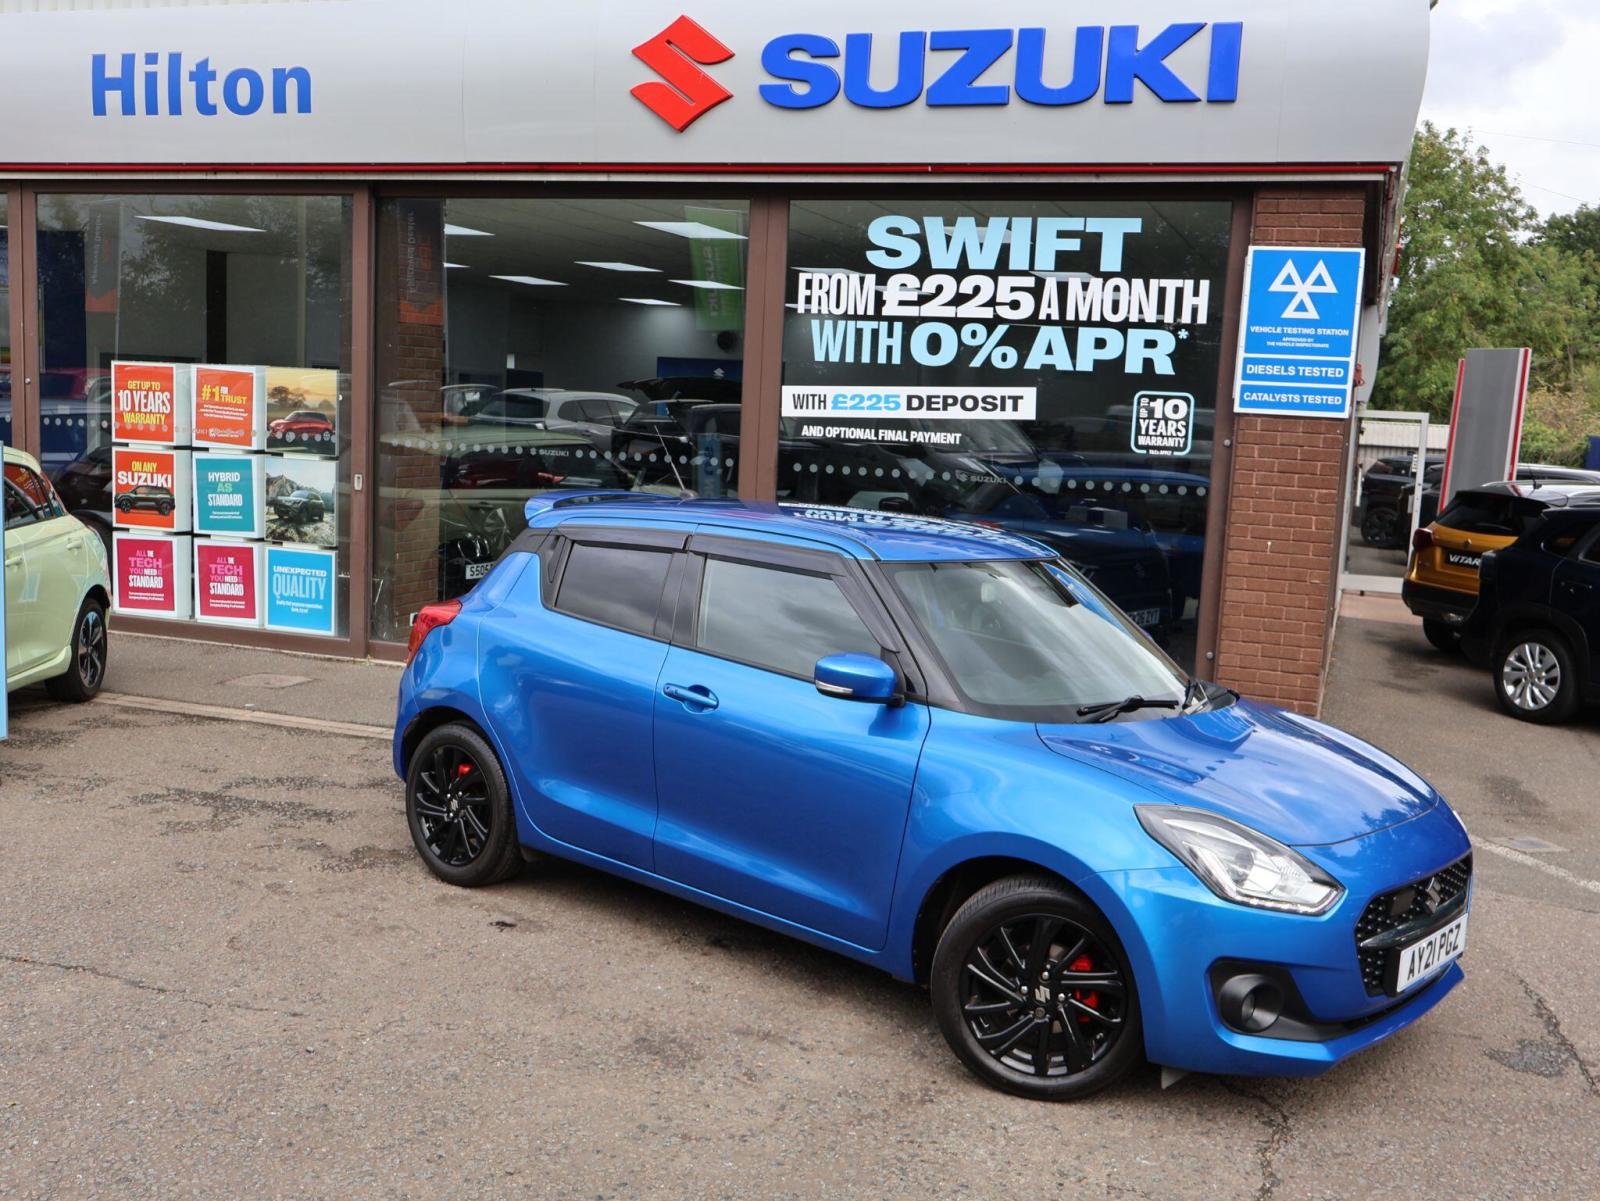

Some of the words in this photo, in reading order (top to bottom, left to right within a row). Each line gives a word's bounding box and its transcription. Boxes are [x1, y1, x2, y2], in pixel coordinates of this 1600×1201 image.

[758, 21, 1243, 109] SUZUKI
[91, 51, 312, 117] Hilton
[865, 215, 1142, 273] SWIFT
[797, 272, 875, 316] FROM
[882, 273, 1036, 320] £225
[1038, 277, 1059, 320] A
[1066, 277, 1210, 325] MONTH
[1250, 326, 1282, 334] VEHICLE
[1283, 327, 1315, 335] TESTING
[1317, 327, 1349, 336] STATION
[811, 319, 902, 365] WITH
[910, 322, 1018, 370] 0%
[1246, 364, 1295, 376] DIESELS
[1298, 366, 1344, 378] TESTED
[127, 381, 140, 390] GET
[141, 381, 151, 390] UP
[151, 381, 161, 390] TO
[201, 384, 220, 402] #1
[220, 394, 248, 405] TRUST
[1244, 392, 1300, 403] CATALYSTS
[1303, 394, 1342, 405] TESTED
[118, 389, 131, 412] 10
[132, 390, 171, 414] YEARS
[792, 393, 827, 410] WITH
[831, 394, 900, 411] £225
[906, 395, 1023, 412] DEPOSIT
[1139, 408, 1148, 418] UP
[1150, 398, 1188, 420] 10
[123, 412, 166, 425] WARRANTY
[801, 425, 823, 437] AND
[825, 426, 877, 440] OPTIONAL
[878, 428, 909, 441] FINAL
[910, 430, 962, 444] PAYMENT
[1139, 419, 1187, 437] YEARS
[1138, 435, 1186, 448] WARRANTY
[538, 448, 569, 456] SUZUKI
[131, 461, 142, 472] ON
[142, 462, 157, 472] ANY
[117, 471, 172, 488] SUZUKI
[207, 472, 241, 483] HYBRID
[970, 475, 1007, 484] SUZUKI
[216, 482, 233, 493] AS
[207, 493, 243, 507] STANDARD
[128, 557, 163, 569] TECH
[216, 556, 227, 564] ALL
[129, 567, 144, 575] YOU
[209, 564, 243, 575] TECH
[273, 565, 327, 577] UNEXPECTED
[128, 575, 164, 589] STANDARD
[209, 574, 225, 582] YOU
[209, 582, 245, 597] STANDARD
[272, 573, 327, 601] QUALITY
[1407, 942, 1436, 981] AY21
[1437, 923, 1461, 962] PGZ
